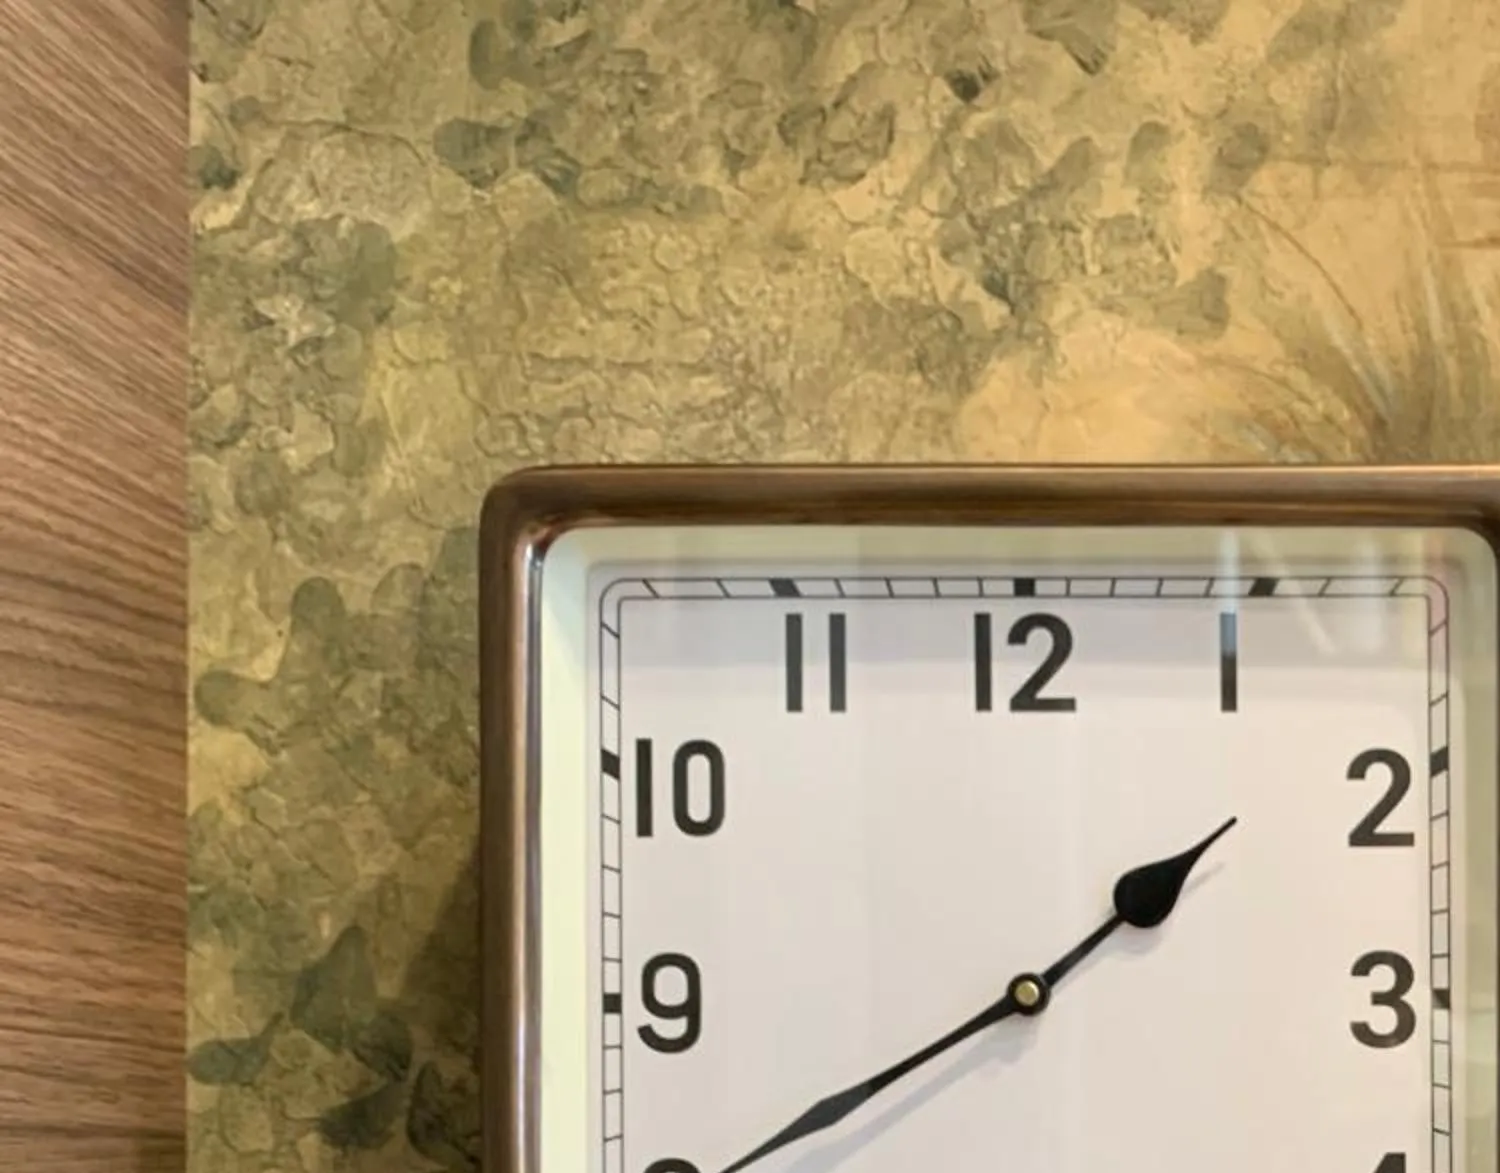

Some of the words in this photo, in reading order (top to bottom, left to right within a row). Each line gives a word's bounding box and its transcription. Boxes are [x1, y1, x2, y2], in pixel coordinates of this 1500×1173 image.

[784, 612, 847, 713] 11
[973, 612, 1078, 713] 12
[1219, 612, 1239, 713] 1
[634, 738, 727, 838] 10
[1345, 748, 1416, 848] 2
[636, 953, 703, 1054] 9
[1348, 951, 1418, 1050] 3
